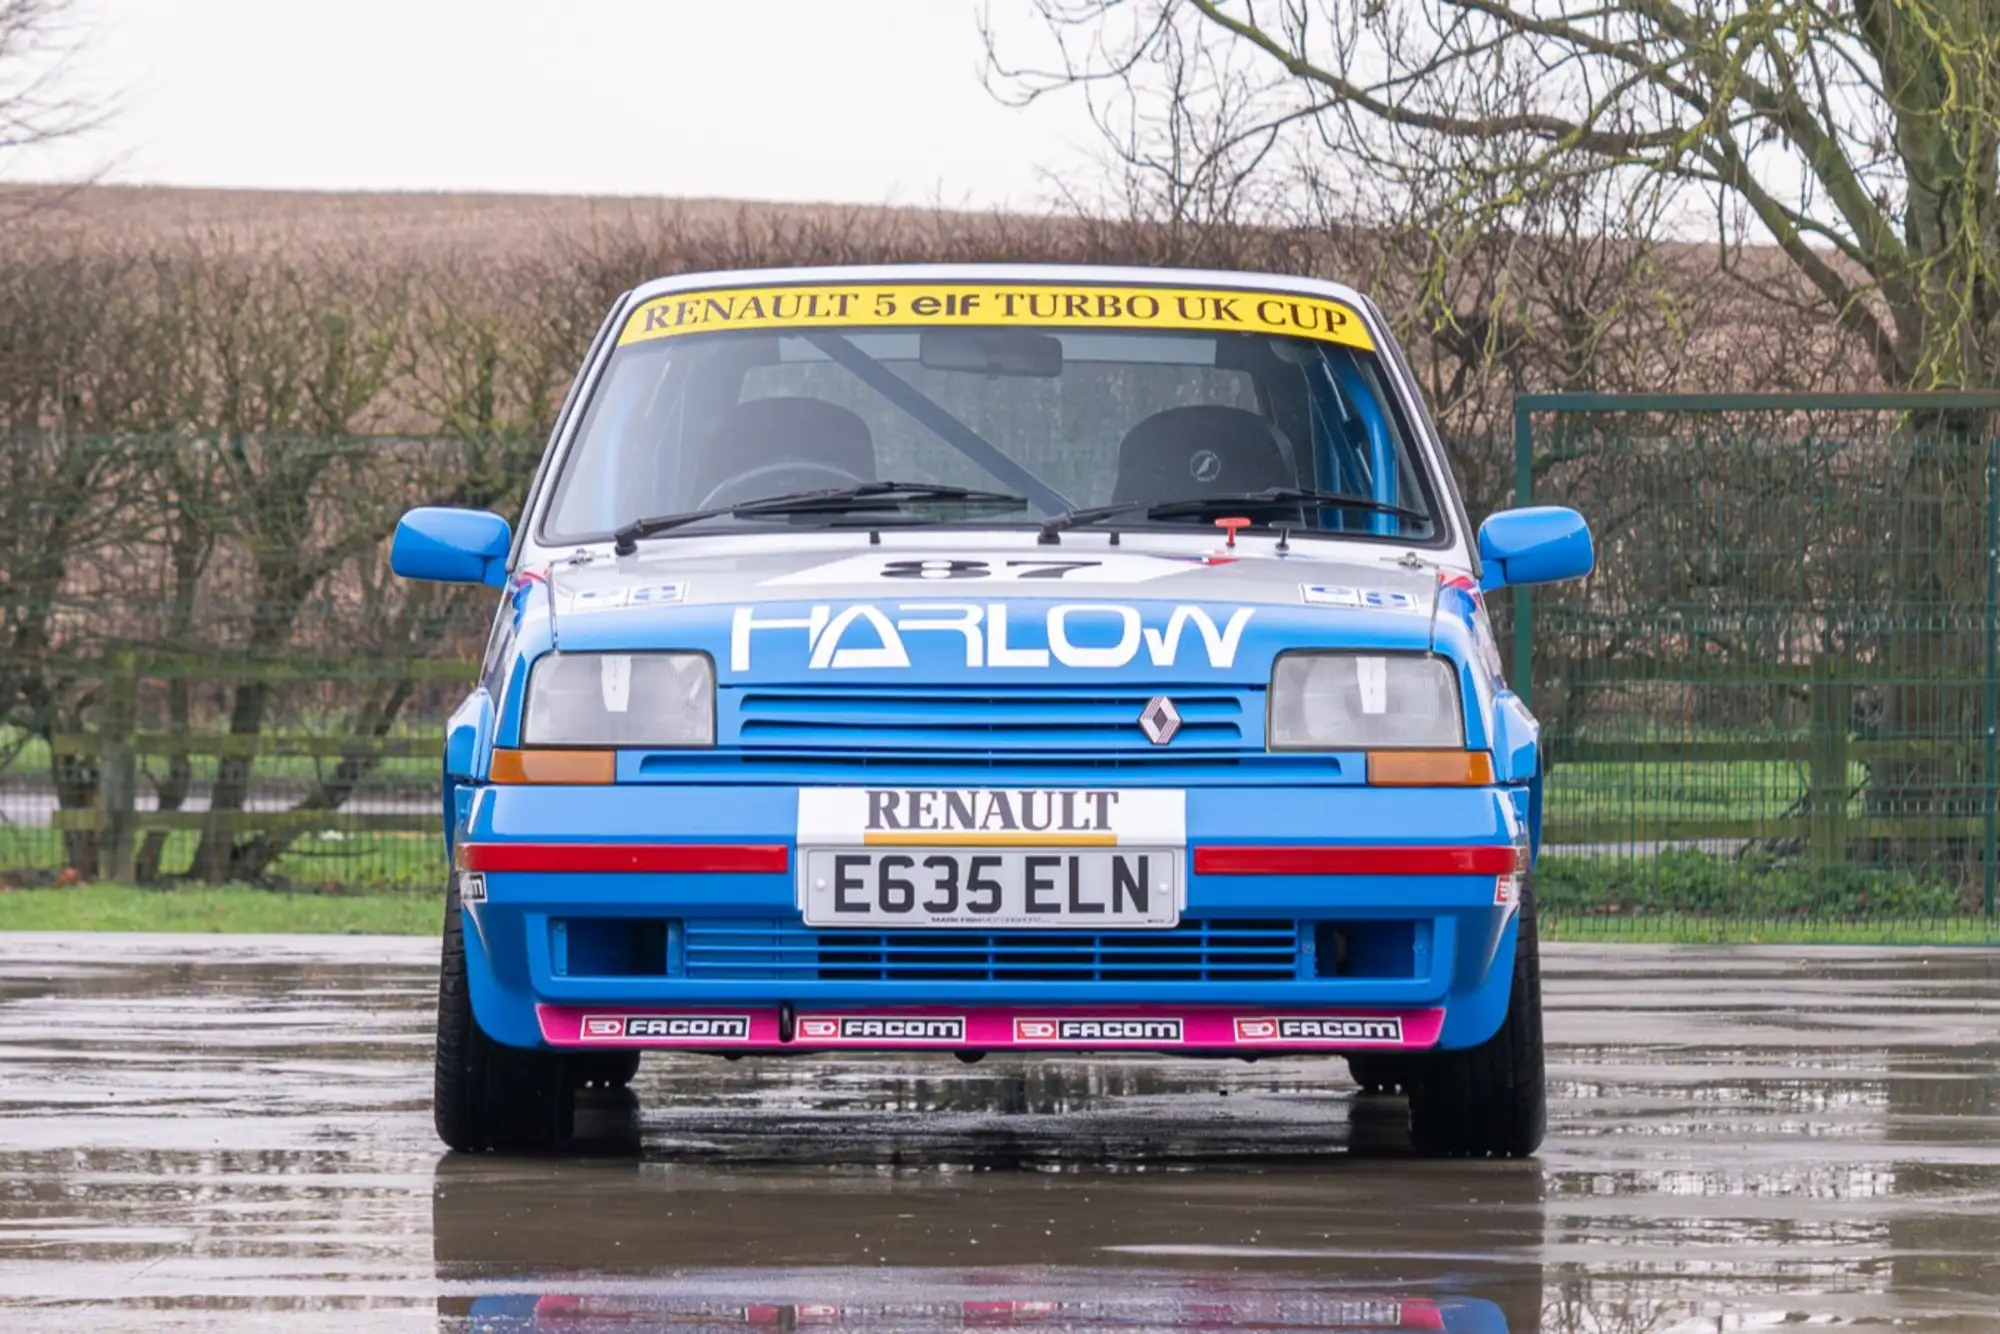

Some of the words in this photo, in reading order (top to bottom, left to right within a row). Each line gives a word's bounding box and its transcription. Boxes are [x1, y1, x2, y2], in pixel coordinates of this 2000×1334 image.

[645, 293, 858, 331] RENAULT
[873, 294, 896, 317] 5
[911, 294, 980, 316] elf
[994, 292, 1160, 318] TURBO
[1177, 296, 1244, 321] UK
[1256, 299, 1347, 333] CUP
[880, 560, 1102, 579] 87
[731, 604, 1256, 671] HARLOW
[865, 790, 1119, 831] RENAULT
[834, 855, 1003, 914] E635
[1025, 855, 1149, 914] ELN
[629, 1019, 744, 1036] FACOM
[845, 1020, 961, 1038] FACOM
[1062, 1022, 1178, 1038] FACOM
[1282, 1021, 1398, 1038] FACOM
